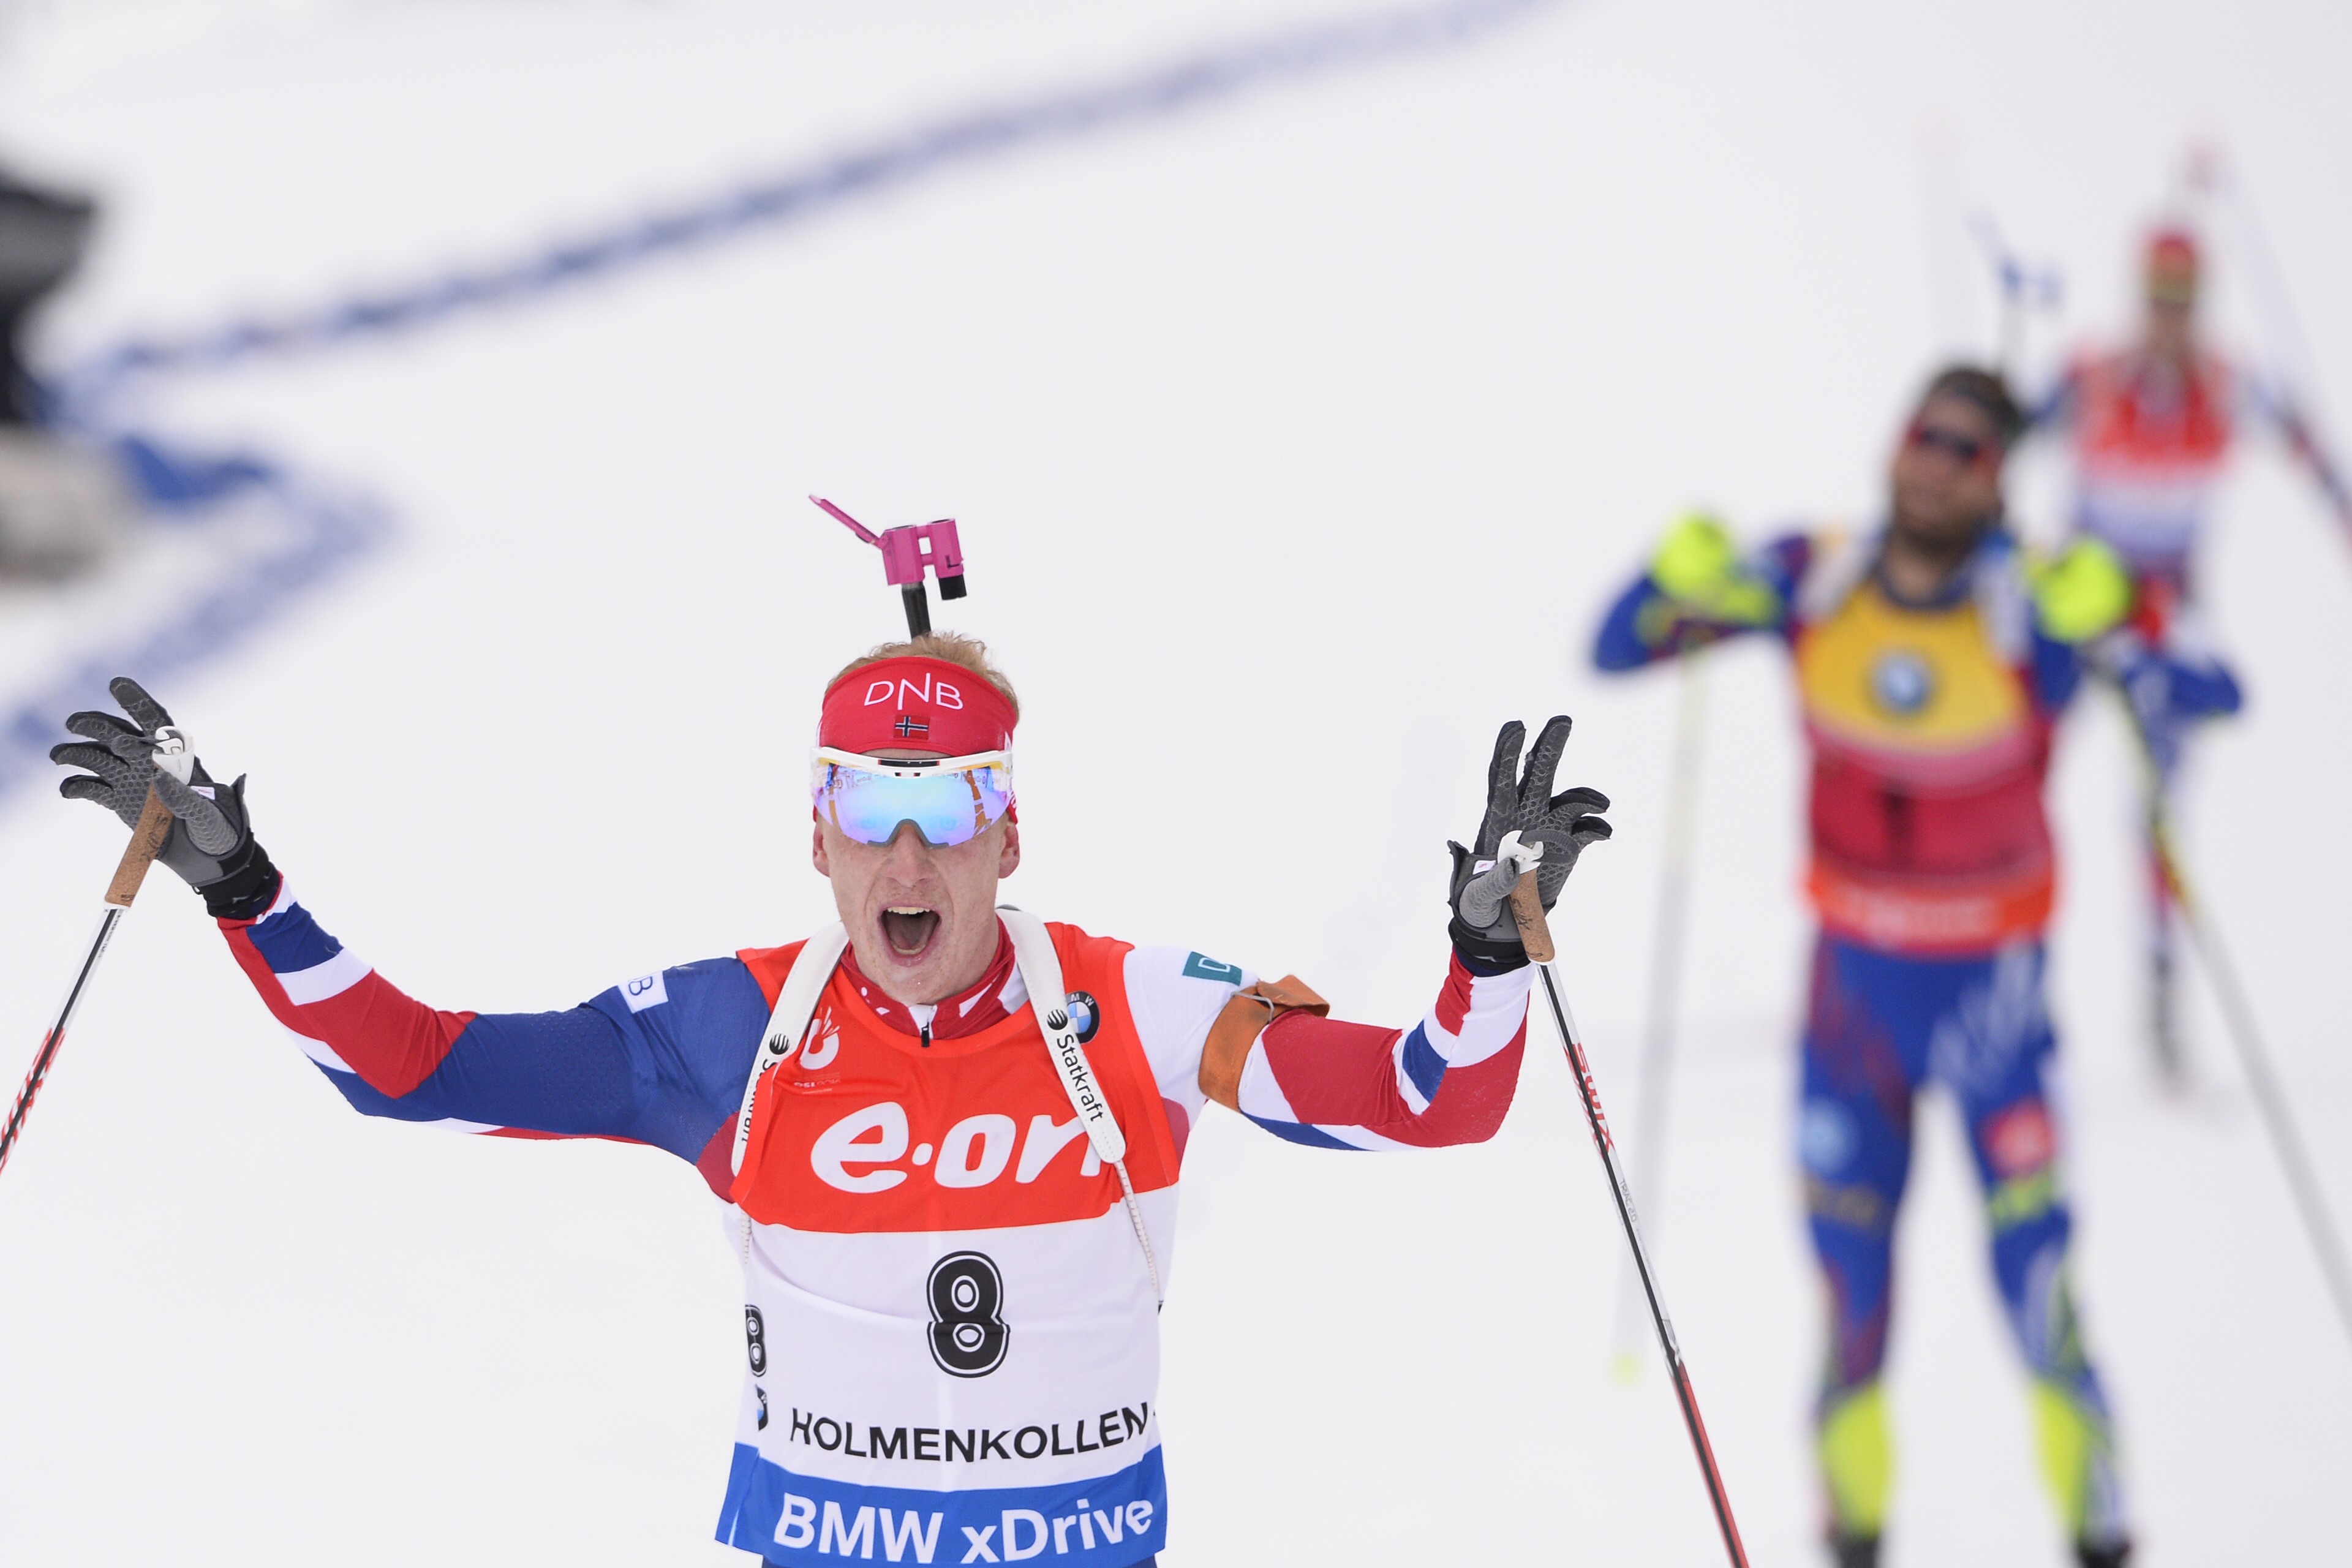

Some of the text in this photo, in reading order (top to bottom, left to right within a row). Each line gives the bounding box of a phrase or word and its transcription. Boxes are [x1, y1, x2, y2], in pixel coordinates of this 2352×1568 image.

[864, 672, 963, 710] DNB
[1057, 1034, 1103, 1122] Statkraft
[925, 1250, 1011, 1378] 8
[789, 1402, 1149, 1462] HOLMENKOLLEN
[774, 1493, 1153, 1564] BMW xDrive
